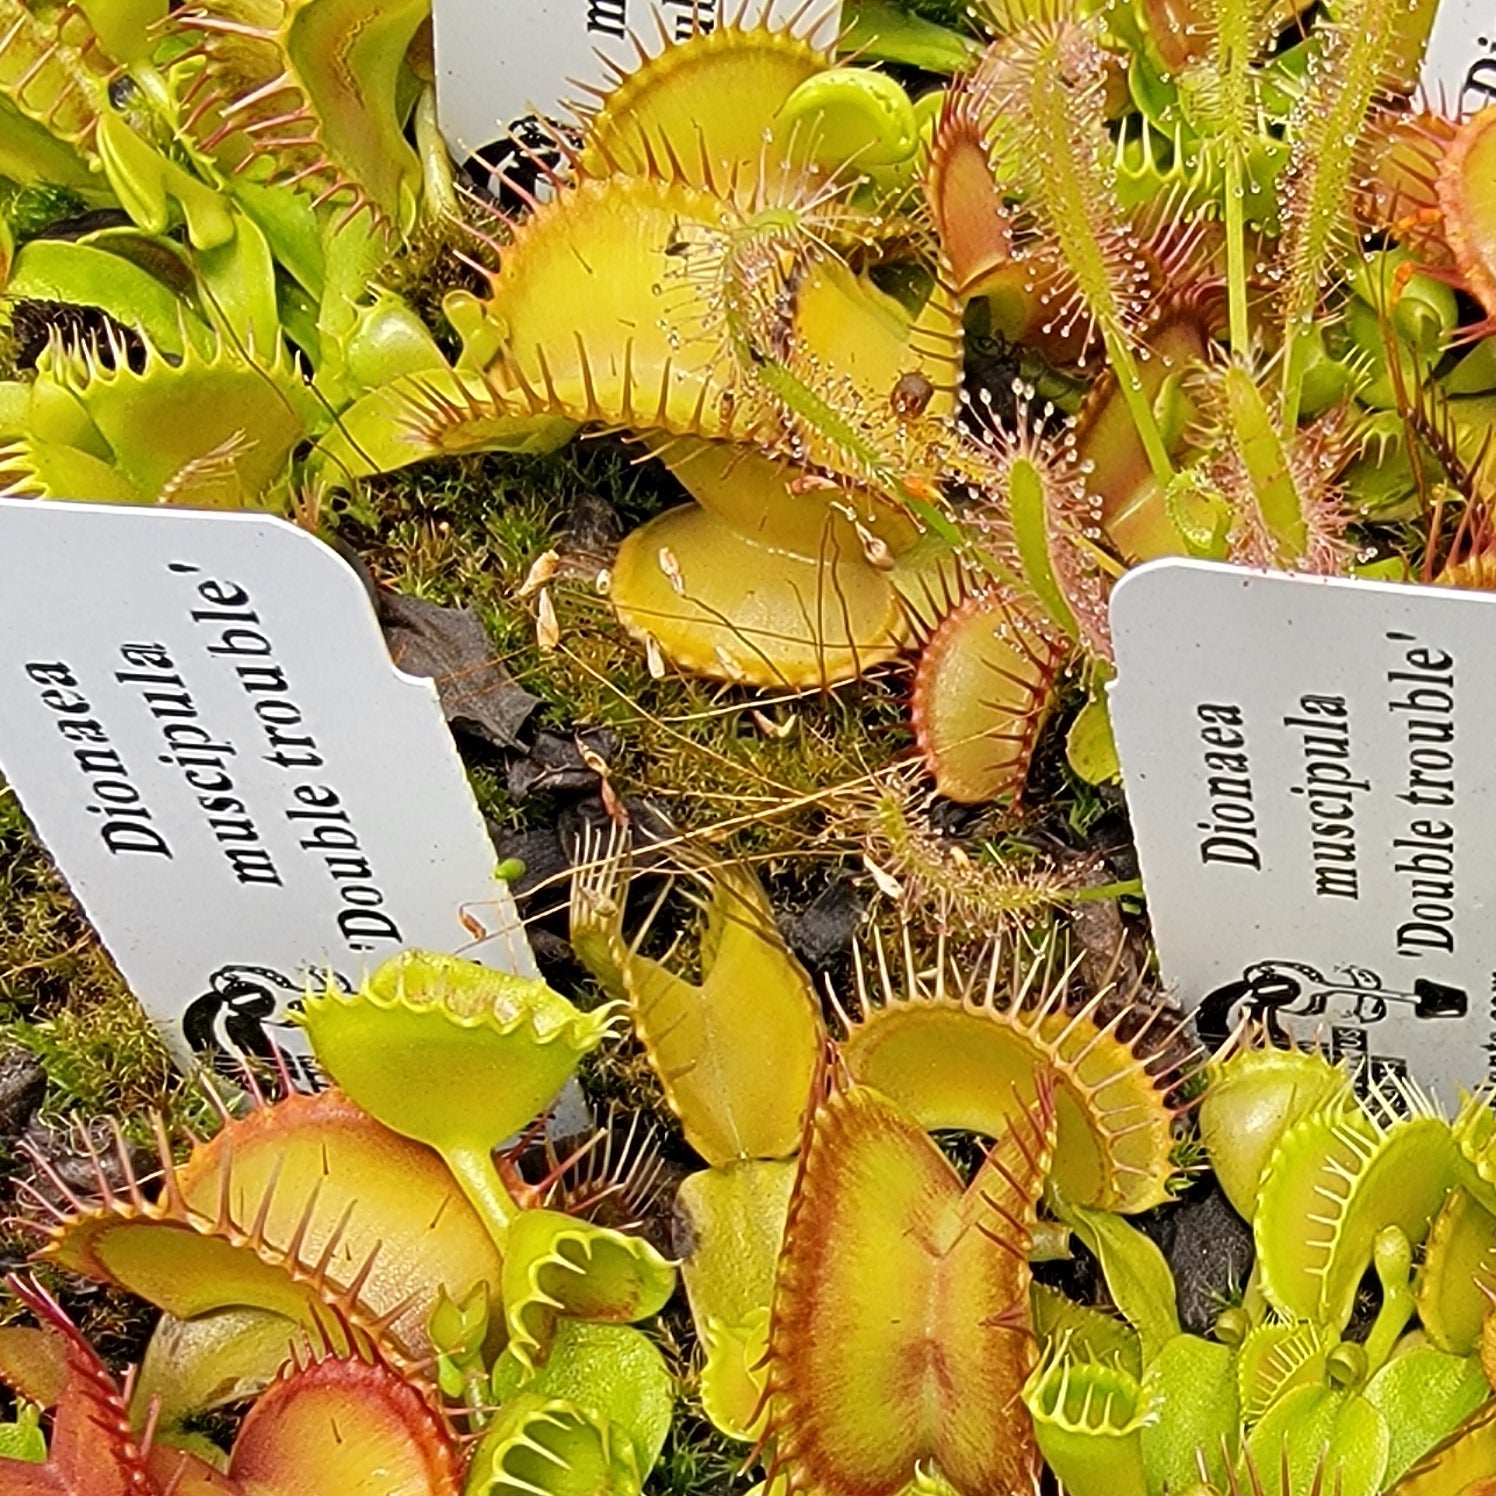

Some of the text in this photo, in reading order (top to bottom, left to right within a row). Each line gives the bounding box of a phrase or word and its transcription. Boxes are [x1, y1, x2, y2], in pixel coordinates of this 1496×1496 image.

[25, 662, 173, 859] Dionaea
[120, 643, 283, 887] muscipula
[168, 563, 403, 951] 'Double trouble'
[1196, 704, 1262, 871] Dionaea
[1283, 694, 1371, 900] muscipula
[1385, 631, 1454, 957] 'Double trouble'
